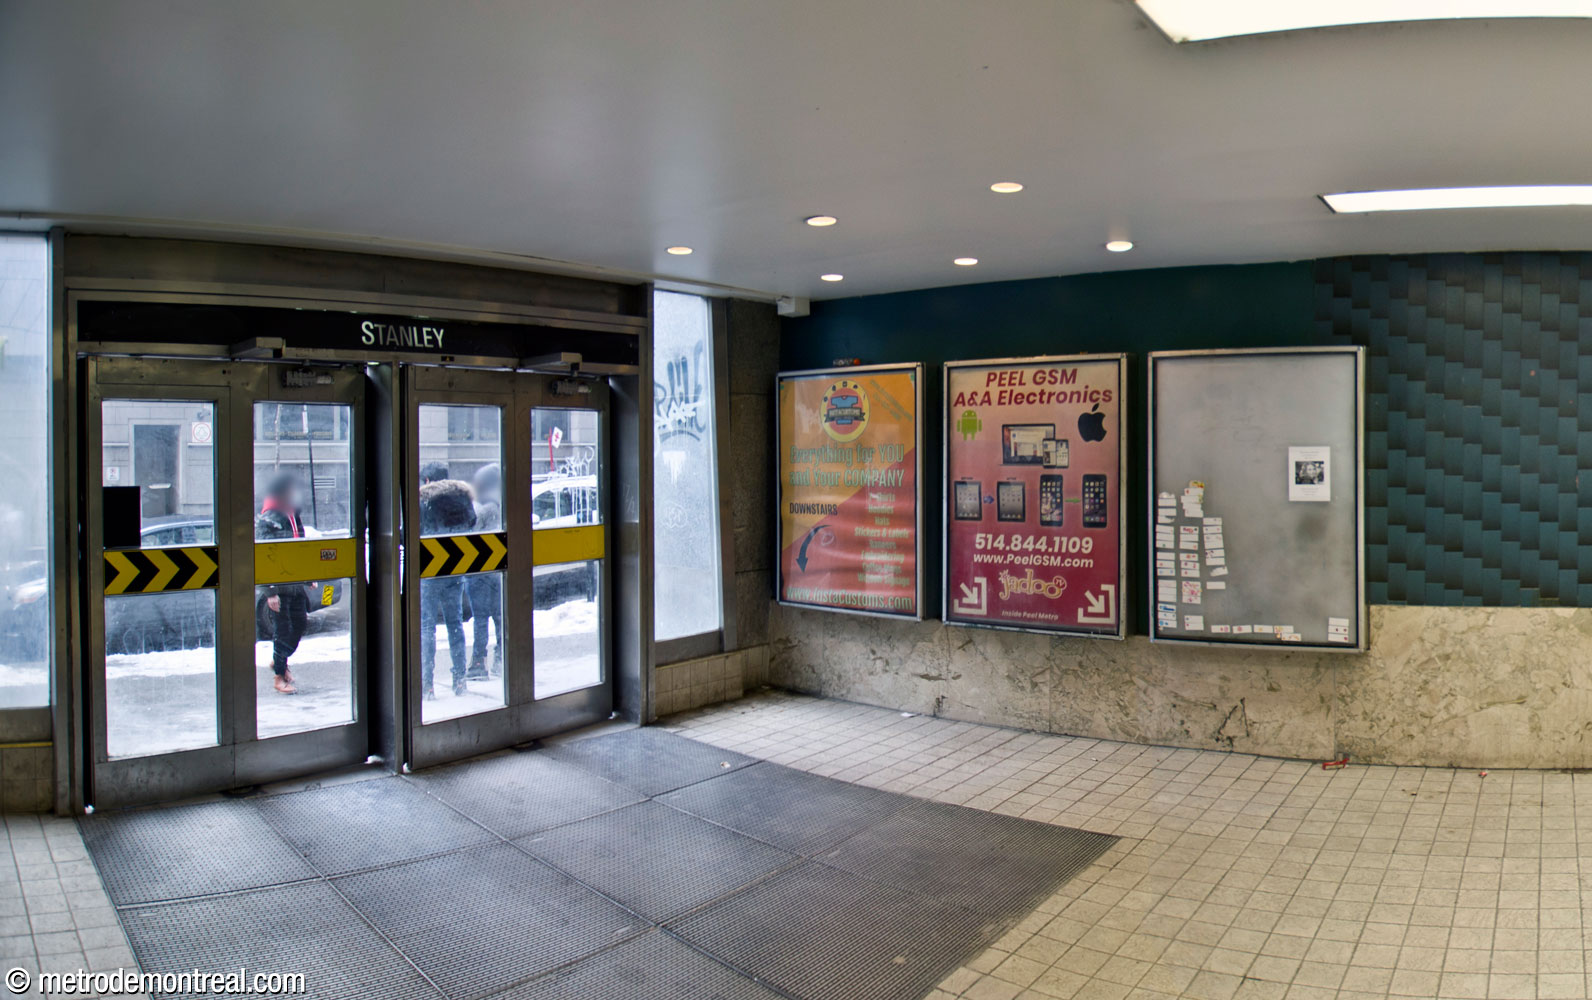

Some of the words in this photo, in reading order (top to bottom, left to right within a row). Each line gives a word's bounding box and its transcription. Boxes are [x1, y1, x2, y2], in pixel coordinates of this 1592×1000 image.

[361, 320, 444, 348] STANLEY
[986, 370, 1027, 388] PEEL
[1032, 368, 1078, 386] GSM
[953, 391, 992, 407] A&A
[997, 385, 1113, 406] Electronics
[790, 445, 853, 467] Everything
[856, 444, 875, 463] for
[878, 443, 904, 463] YOU
[790, 468, 810, 486] and
[813, 469, 840, 487] Your
[844, 468, 904, 487] COMPANY
[789, 502, 838, 516] DOWNSTAIRS
[975, 533, 1093, 554] 514.844.1109
[973, 554, 1093, 568] www.PeelGSM.com
